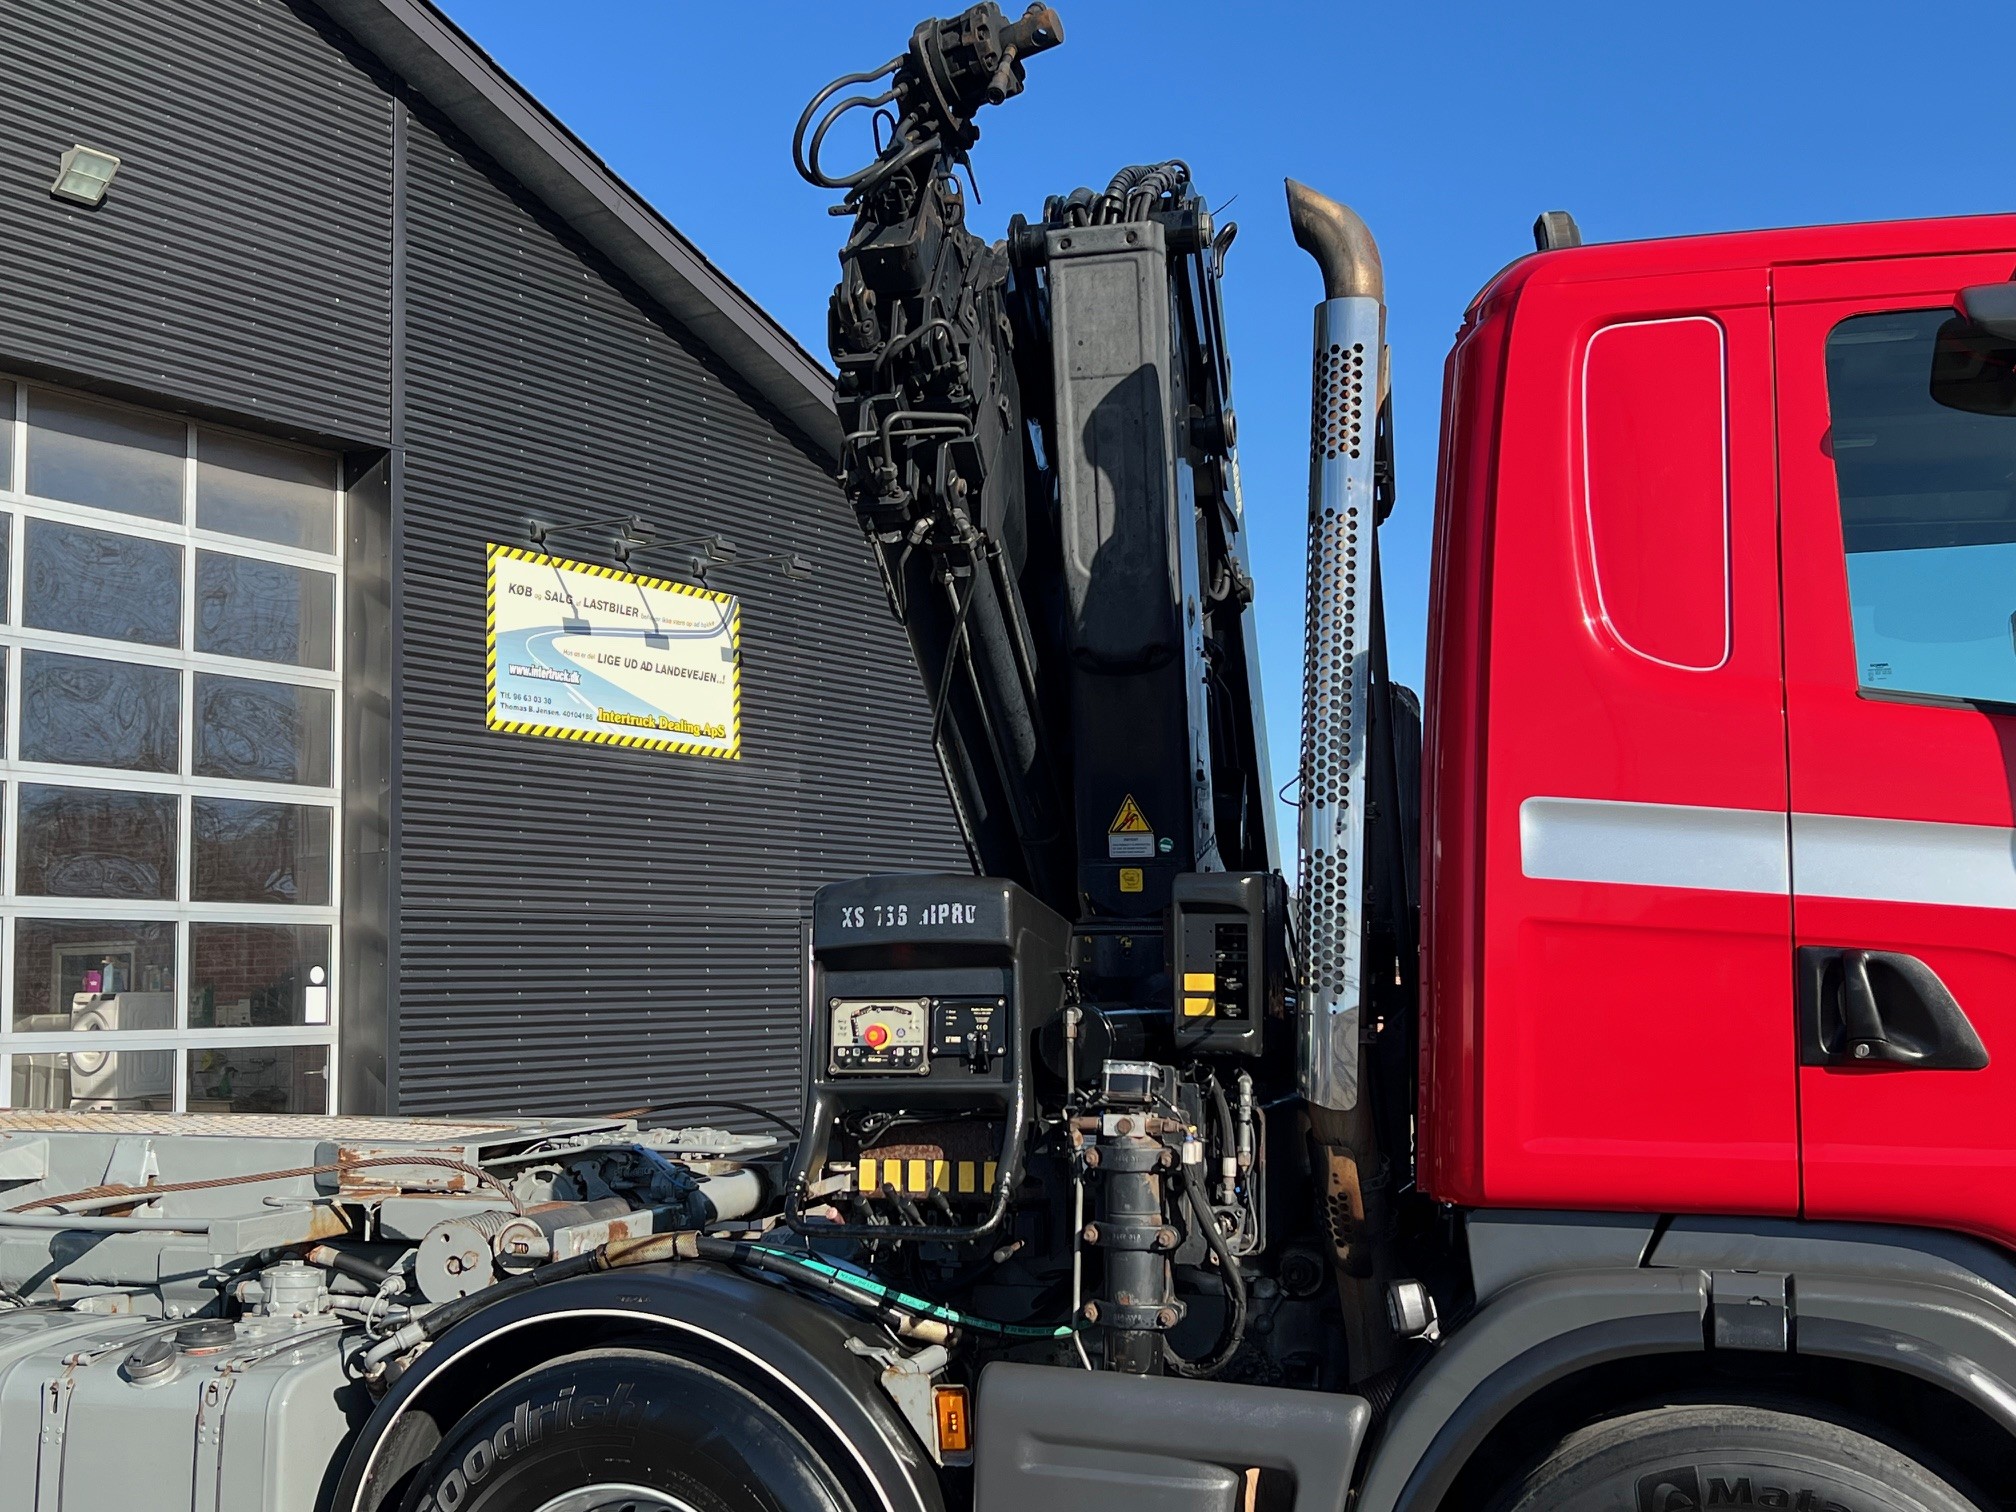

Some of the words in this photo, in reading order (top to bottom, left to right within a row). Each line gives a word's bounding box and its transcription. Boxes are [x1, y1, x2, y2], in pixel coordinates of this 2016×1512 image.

[508, 583, 532, 597] KØB
[544, 589, 573, 605] SALG
[583, 597, 639, 617] LASTBILER
[597, 653, 621, 667] LIGE
[624, 658, 638, 669] UD
[640, 660, 653, 672] AD
[508, 663, 581, 685] www.intertruck.dk
[500, 702, 527, 712] Thomas
[513, 693, 522, 701] 96
[523, 694, 532, 702] 63
[533, 696, 542, 704] 03
[543, 697, 552, 705] 30
[597, 707, 656, 728] Intertruck
[659, 715, 701, 737] Dealing
[702, 722, 726, 739] ApS
[841, 906, 865, 928] XS
